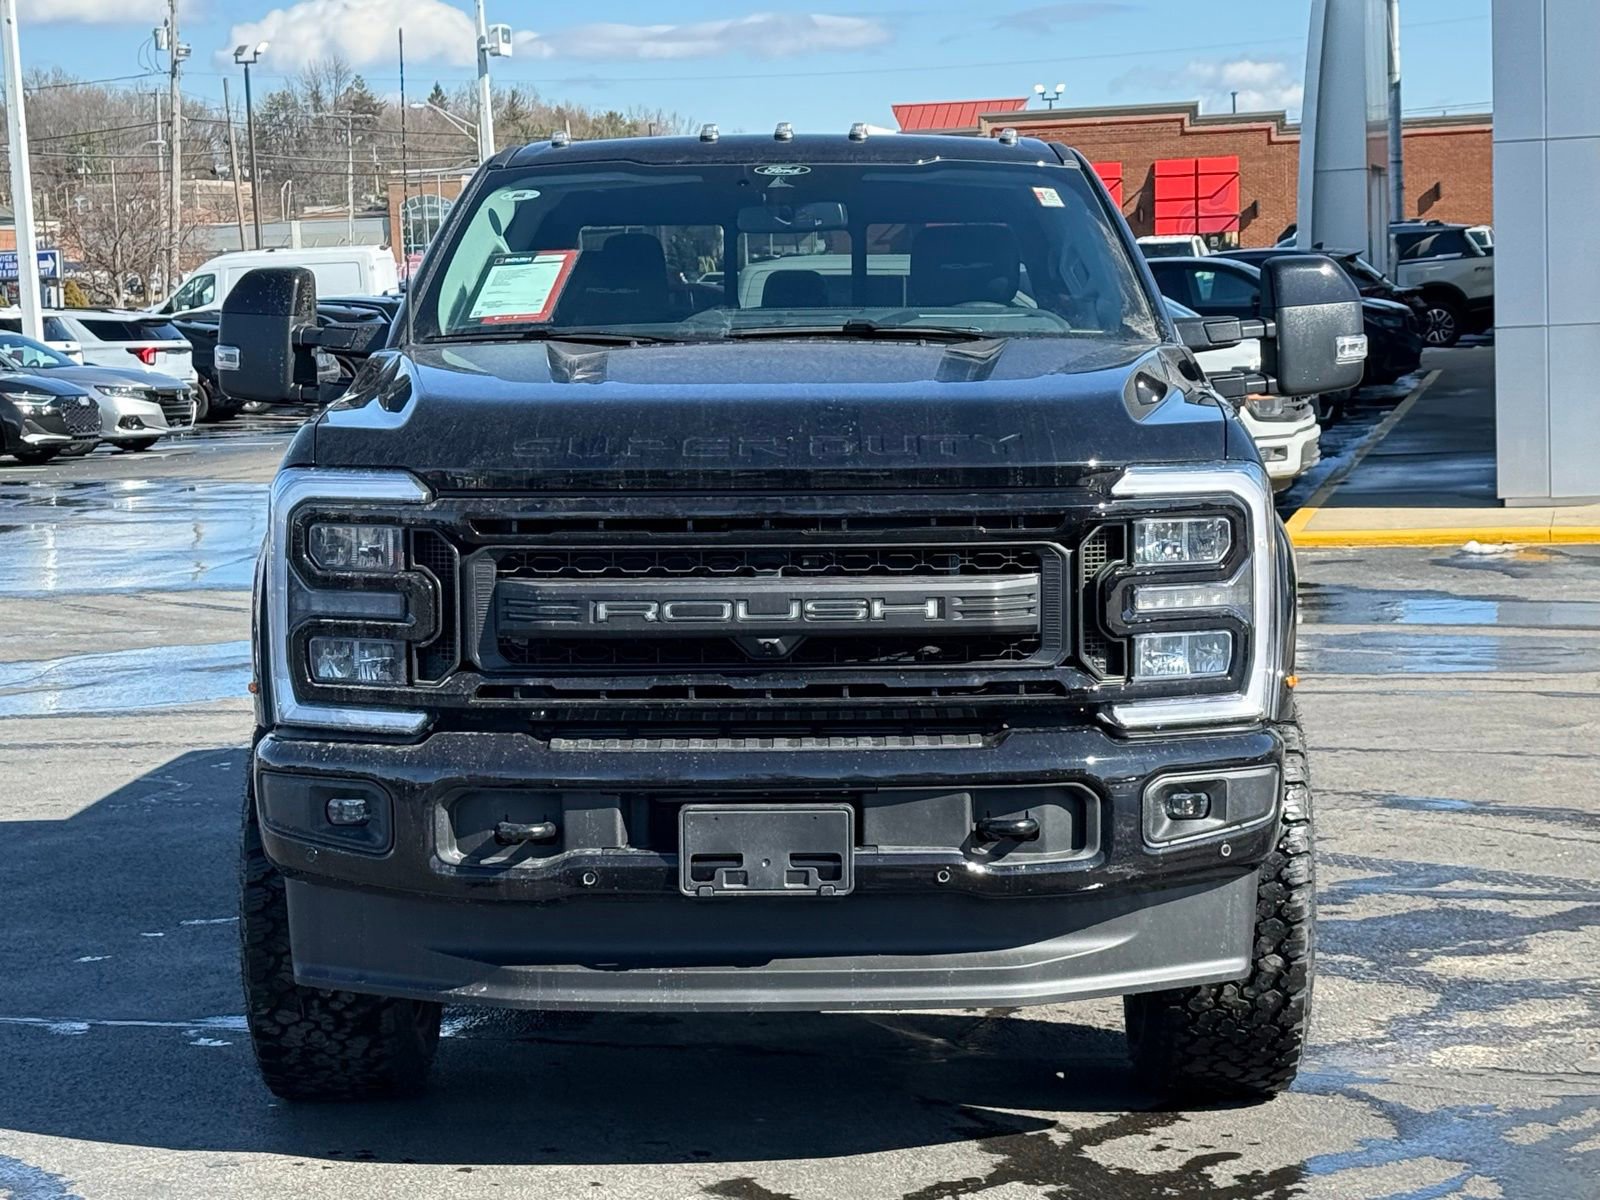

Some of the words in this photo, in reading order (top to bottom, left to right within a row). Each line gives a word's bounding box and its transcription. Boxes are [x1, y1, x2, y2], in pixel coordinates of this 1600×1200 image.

[512, 437, 789, 457] SUPER
[809, 433, 1023, 456] DUTY
[589, 597, 946, 623] ROUSH
